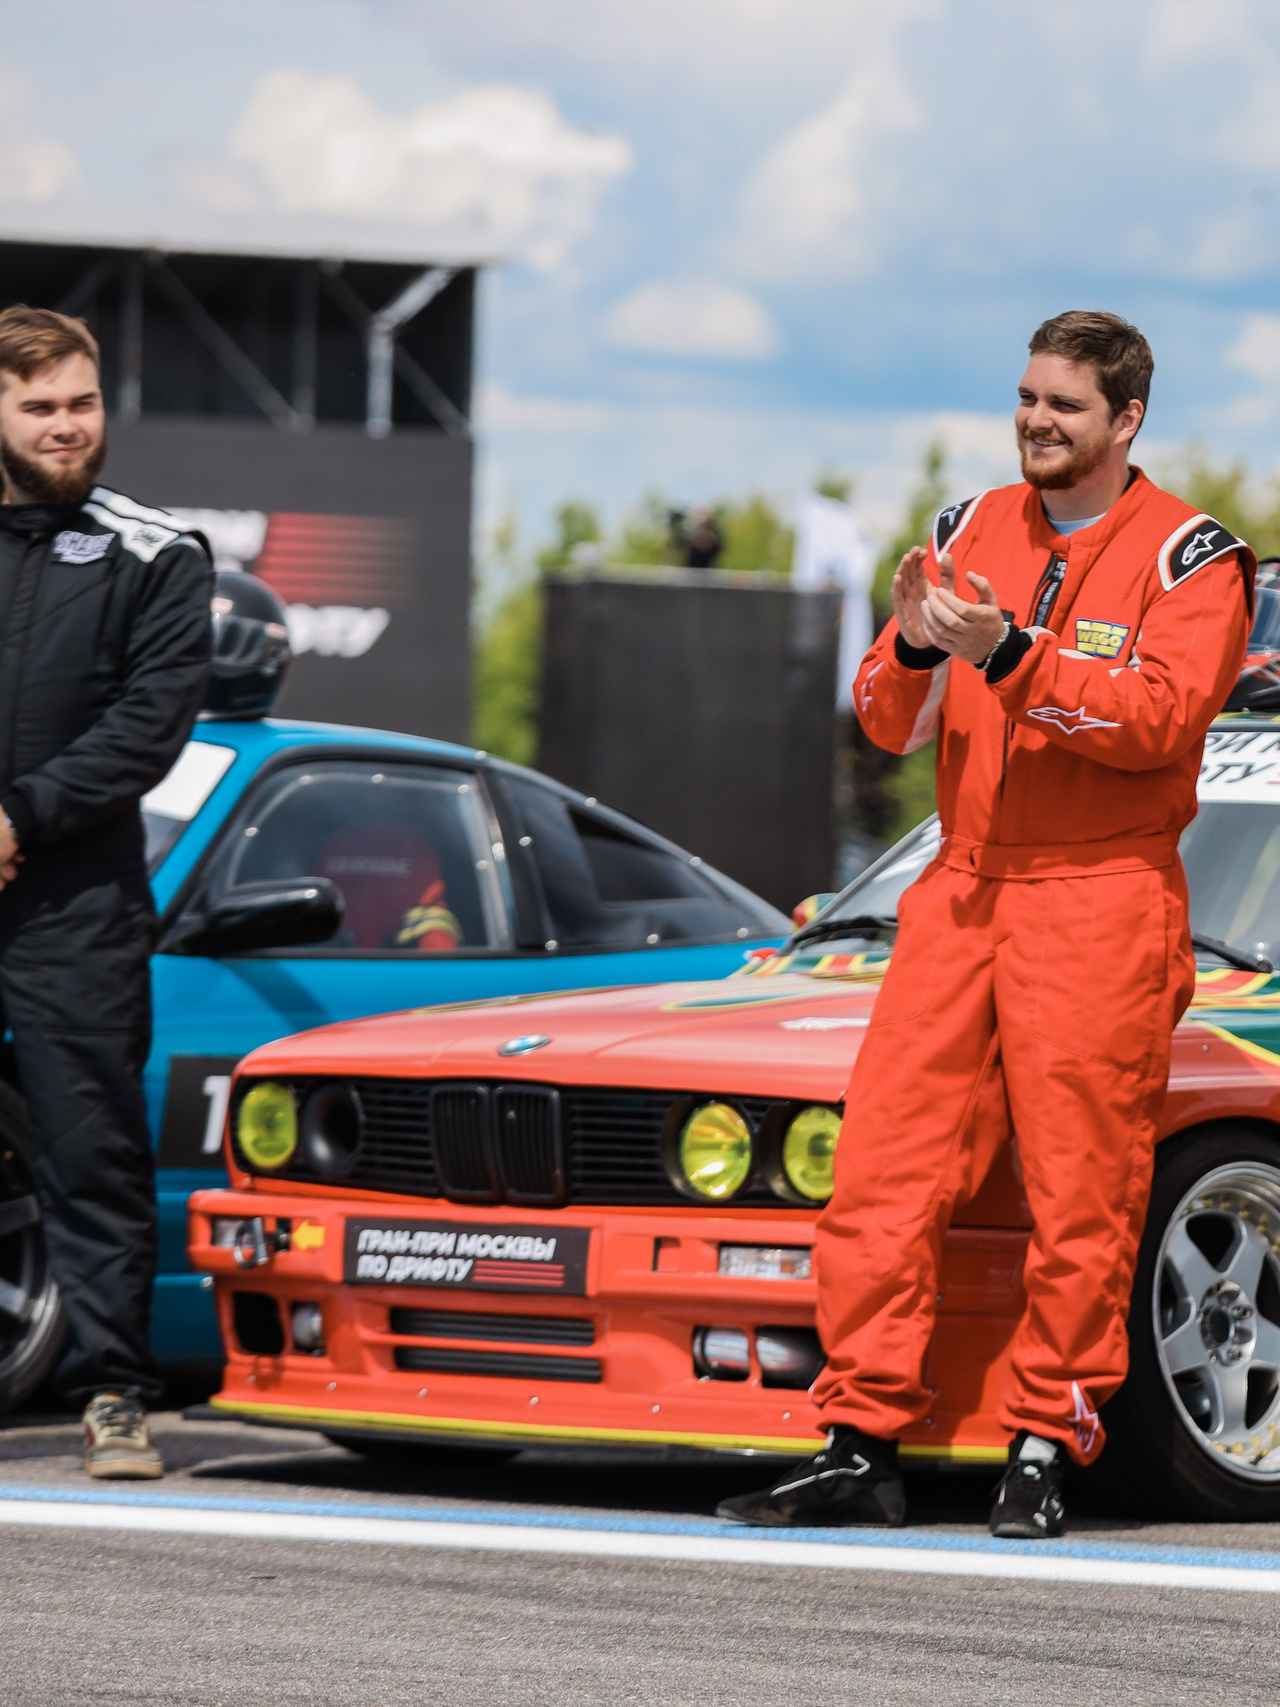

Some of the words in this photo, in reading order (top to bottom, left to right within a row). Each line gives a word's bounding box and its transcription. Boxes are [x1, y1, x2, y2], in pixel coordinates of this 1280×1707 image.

[1077, 629, 1122, 648] WEGO
[357, 1229, 457, 1256] ГРАН-ПРИ
[456, 1233, 557, 1261] МОСКВЫ
[357, 1254, 389, 1279] ПО
[385, 1256, 474, 1282] ДРИФТУ
